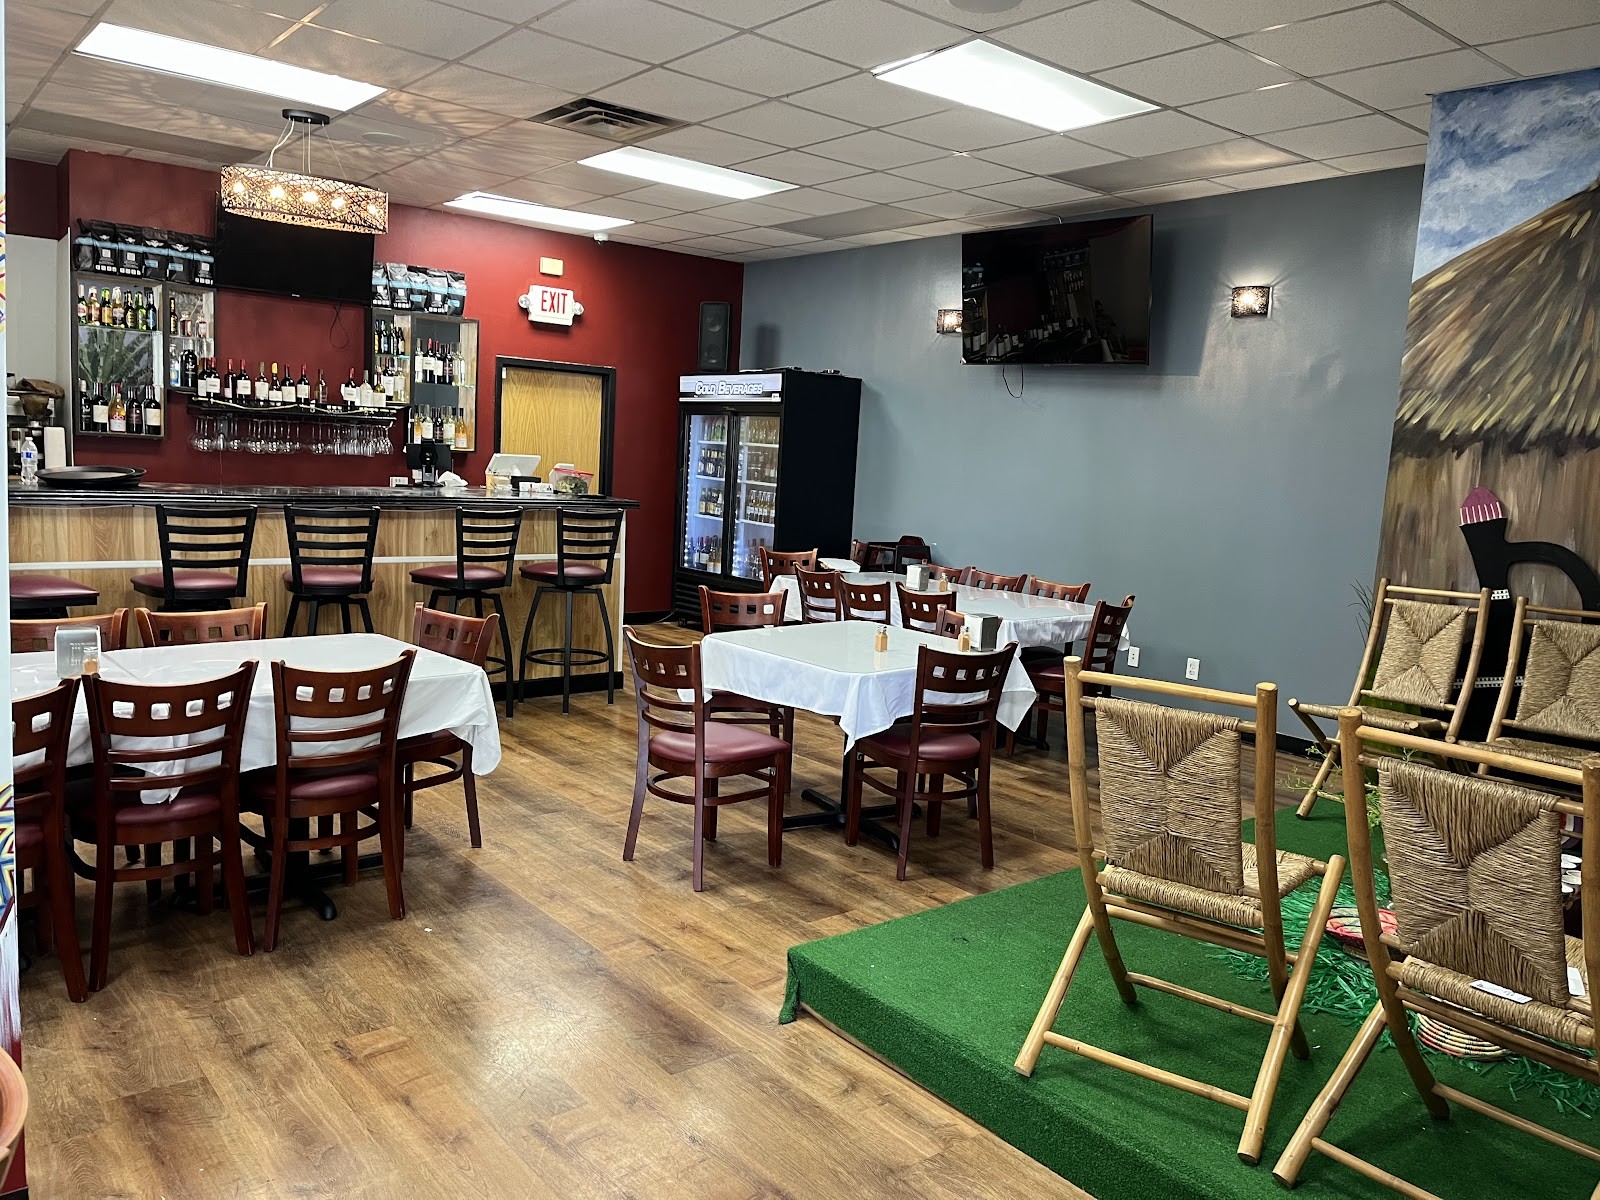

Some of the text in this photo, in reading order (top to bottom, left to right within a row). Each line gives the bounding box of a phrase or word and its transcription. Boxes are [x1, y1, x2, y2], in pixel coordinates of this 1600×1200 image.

[541, 290, 568, 314] EXIT
[695, 380, 763, 395] COLD BEVERAGES
